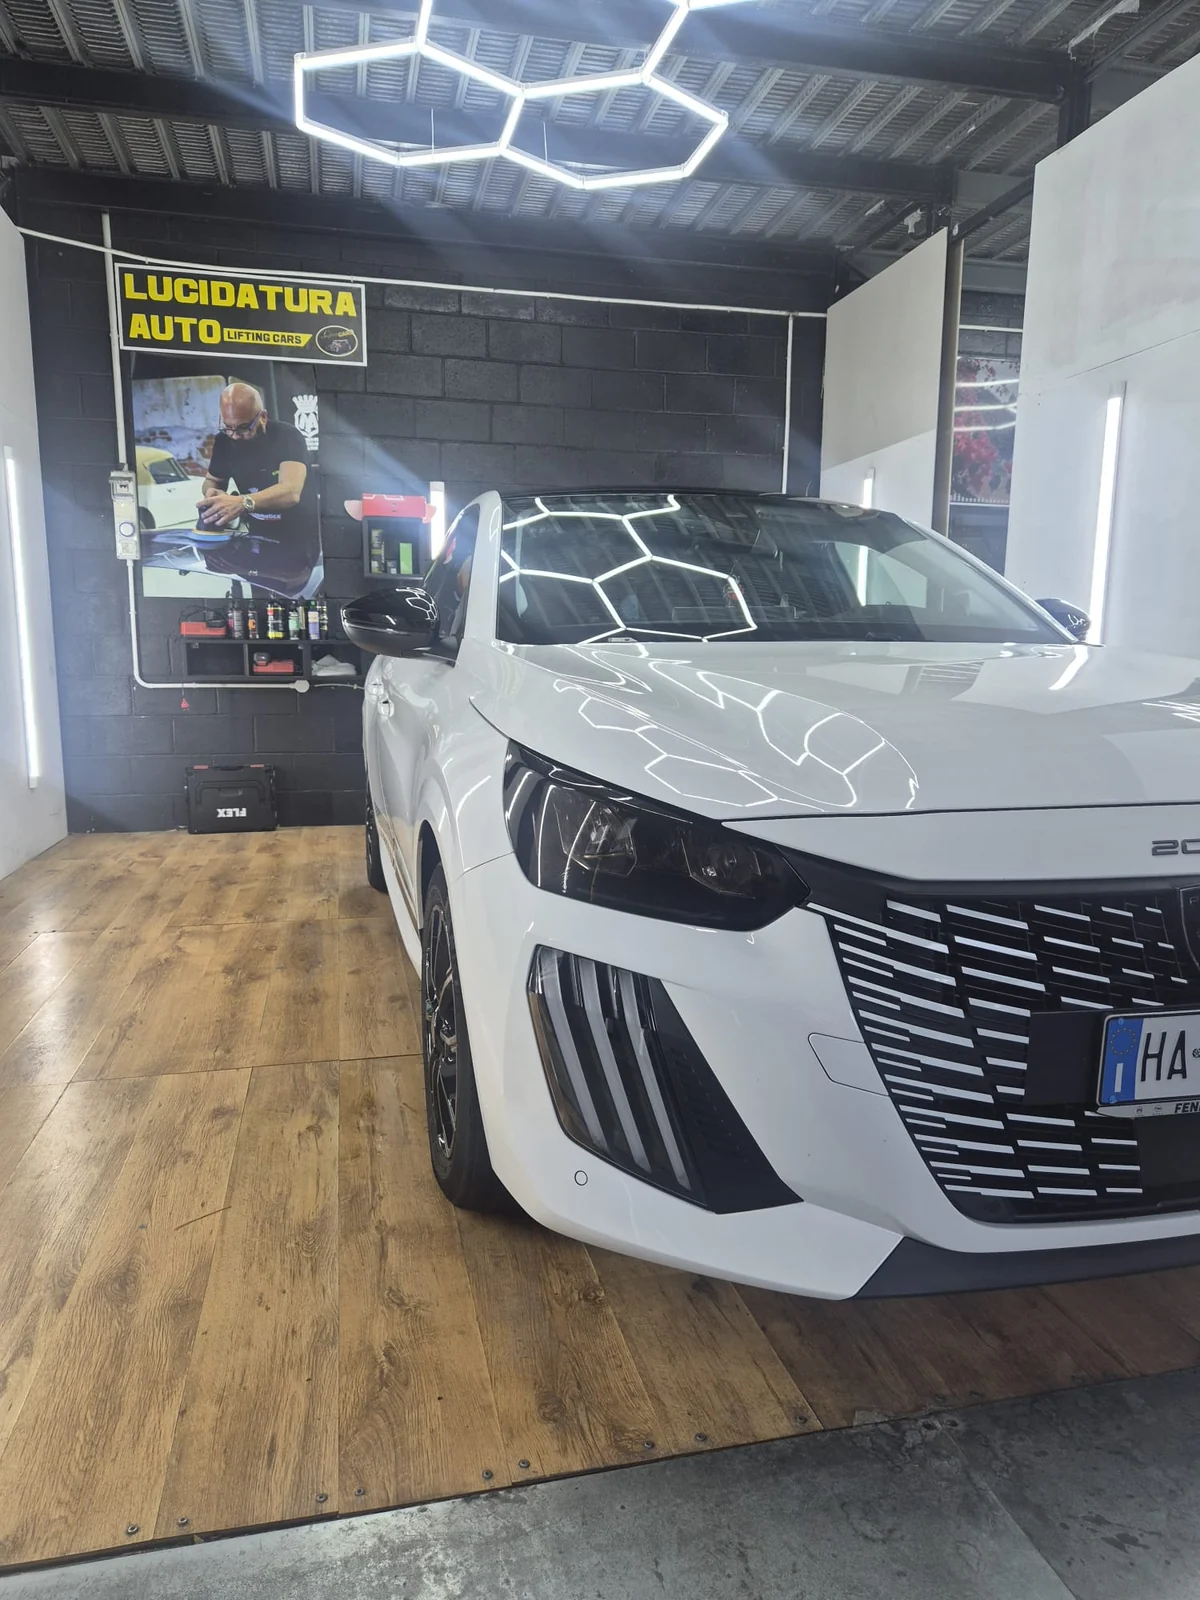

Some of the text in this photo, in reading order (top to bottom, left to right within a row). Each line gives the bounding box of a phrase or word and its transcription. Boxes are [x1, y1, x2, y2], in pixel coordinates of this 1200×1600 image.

[124, 273, 357, 317] LUCIDATURA
[129, 313, 221, 344] AUTO
[227, 331, 302, 344] LIFTING CARS
[216, 807, 247, 818] FLEX
[1140, 1030, 1188, 1082] HA
[1174, 1101, 1200, 1114] FEN
